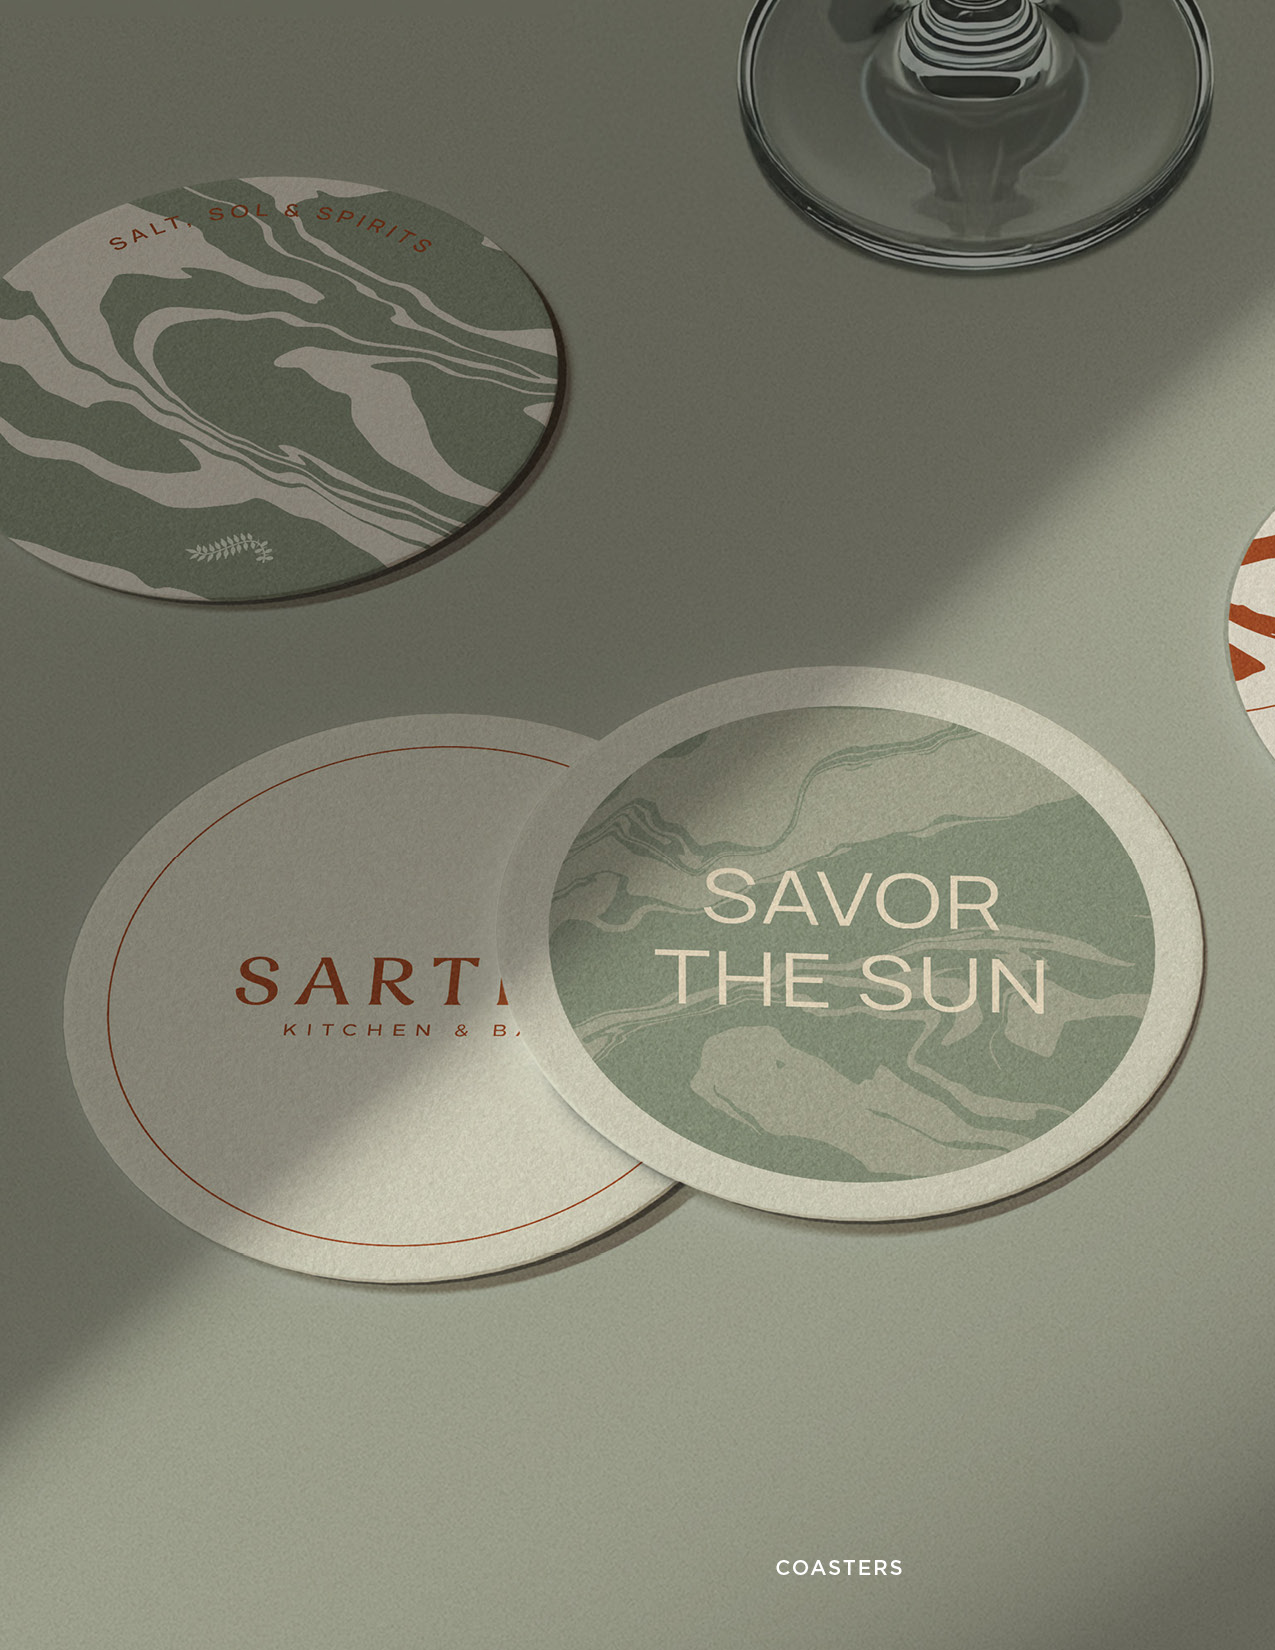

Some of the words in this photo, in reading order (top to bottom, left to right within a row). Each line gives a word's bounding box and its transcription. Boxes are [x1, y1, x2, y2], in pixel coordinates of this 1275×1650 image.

[108, 215, 192, 251] SALT,
[208, 203, 269, 221] SOL
[284, 203, 300, 218] &
[316, 206, 433, 254] SPIRITS
[703, 867, 1000, 932] SAVOR
[654, 948, 830, 1009] THE
[859, 954, 1045, 1015] SUN
[282, 1023, 432, 1037] KITCHEN
[454, 1023, 469, 1037] &
[492, 1023, 521, 1037] B
